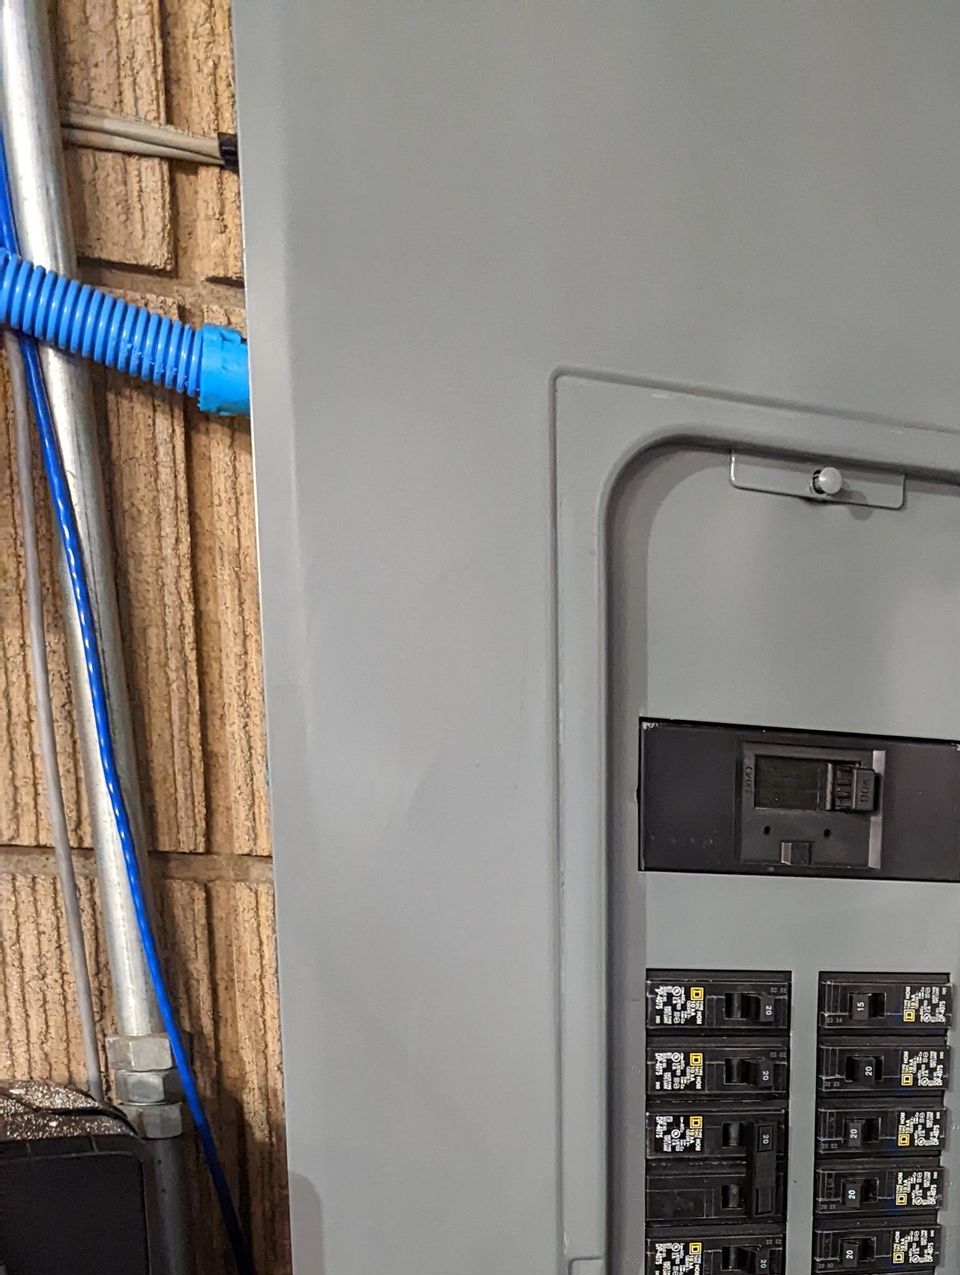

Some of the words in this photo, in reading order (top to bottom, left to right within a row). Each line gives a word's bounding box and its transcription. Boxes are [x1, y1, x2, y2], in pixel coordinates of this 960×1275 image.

[765, 1005, 773, 1016] 20
[857, 1001, 865, 1012] 15
[762, 1070, 770, 1082] 20
[865, 1065, 873, 1077] 20
[850, 1128, 858, 1139] 20
[762, 1134, 770, 1145] 20
[848, 1189, 856, 1200] 20
[846, 1249, 854, 1260] 20
[760, 1259, 768, 1269] 20
